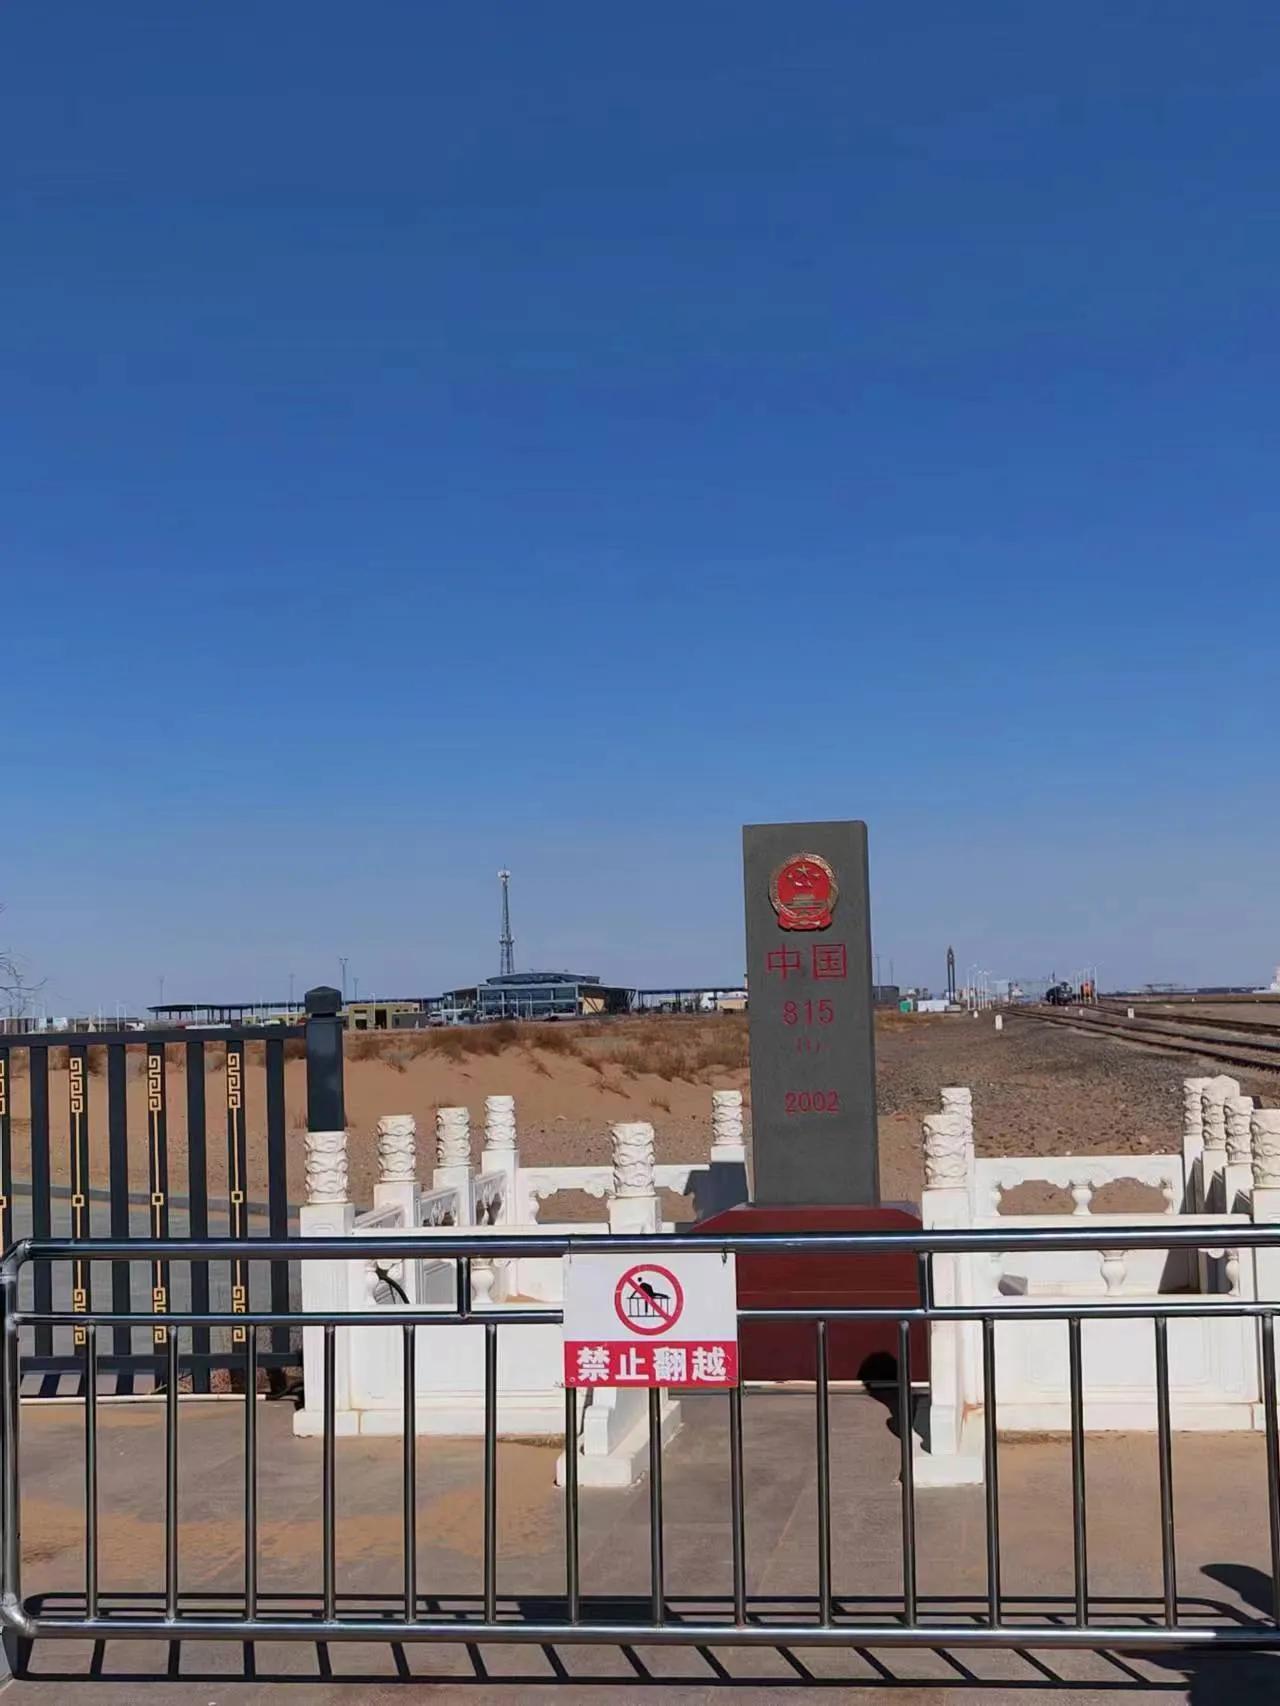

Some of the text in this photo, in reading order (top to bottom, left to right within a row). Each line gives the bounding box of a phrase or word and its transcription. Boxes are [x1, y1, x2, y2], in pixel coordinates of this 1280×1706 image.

[767, 943, 847, 980] 中国
[783, 999, 834, 1026] 815
[784, 1090, 840, 1114] 2002
[577, 1346, 727, 1382] 禁止翻越
